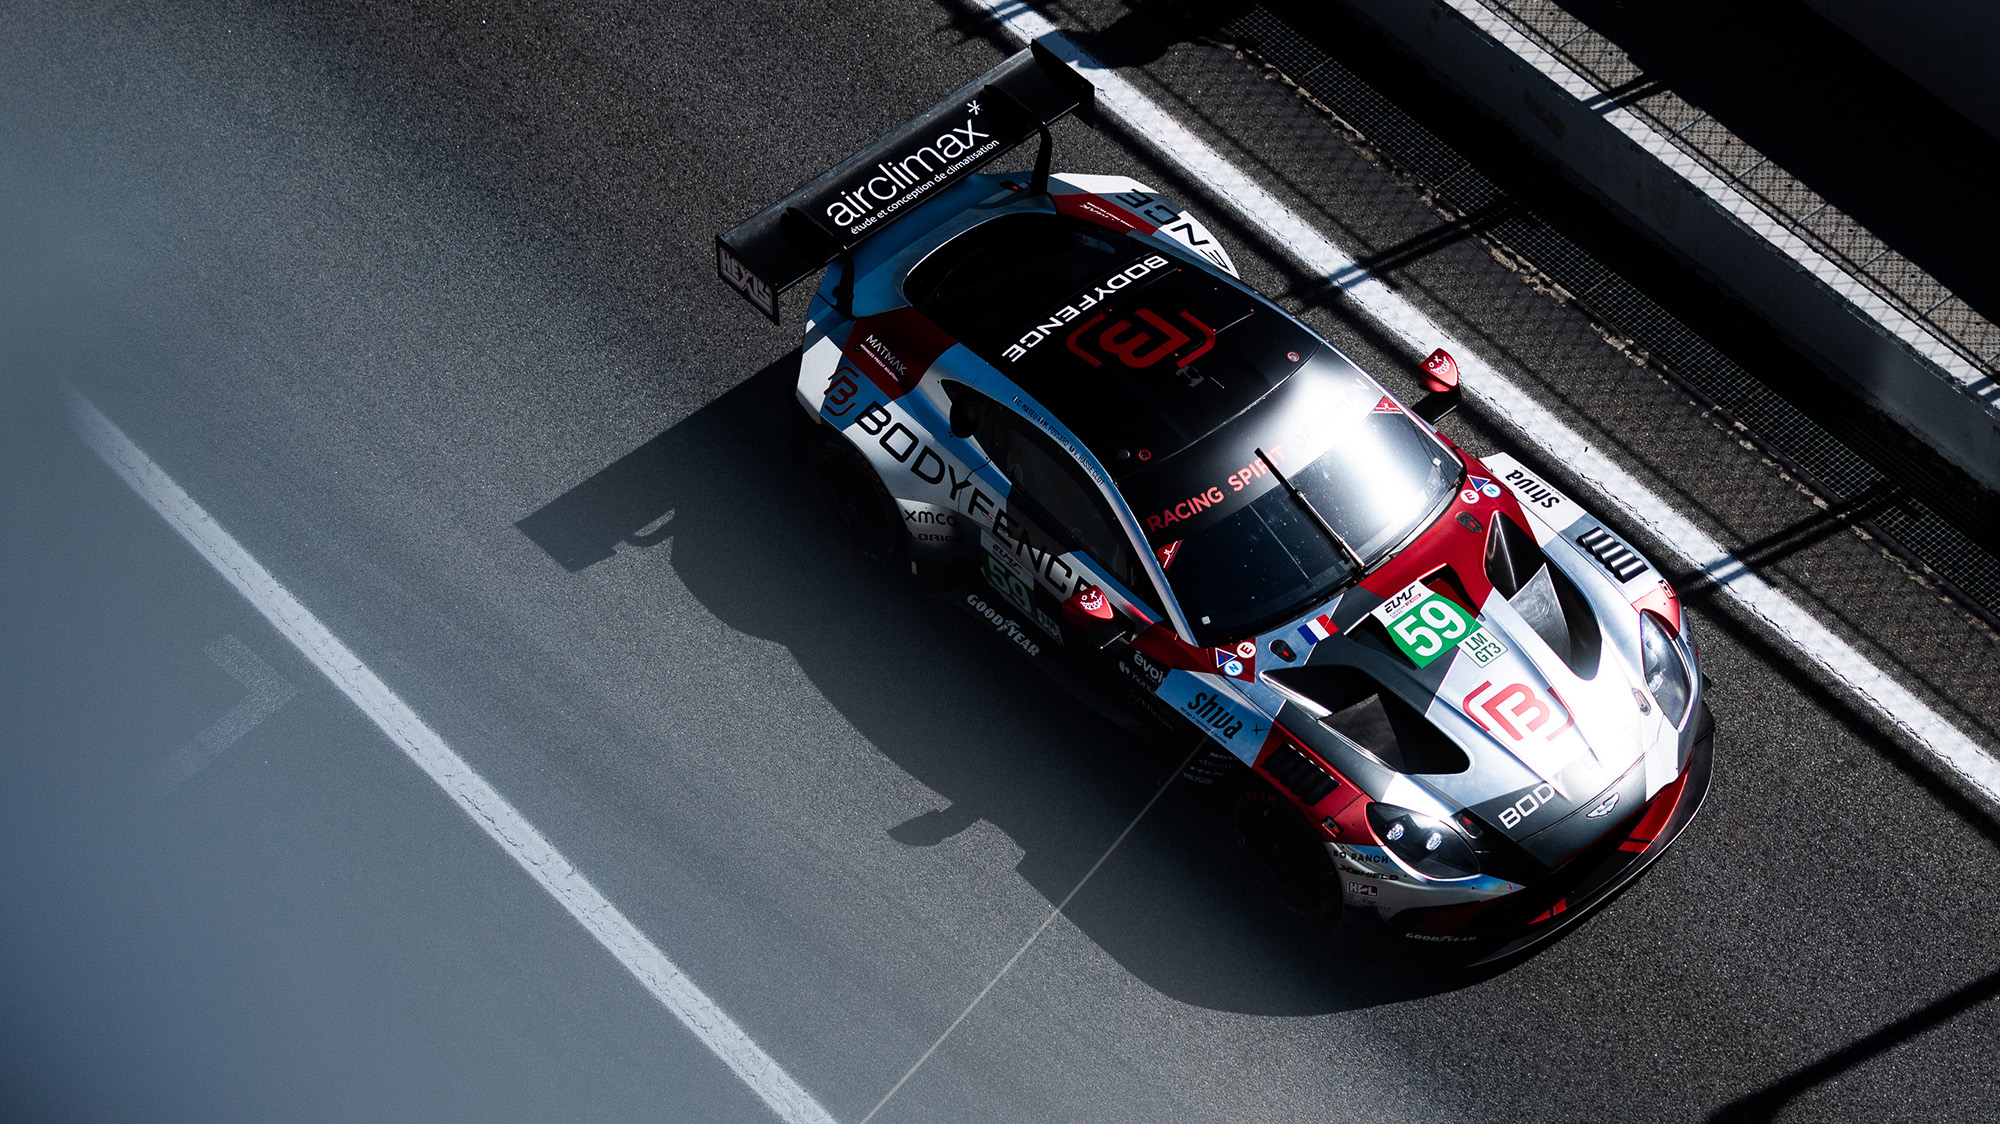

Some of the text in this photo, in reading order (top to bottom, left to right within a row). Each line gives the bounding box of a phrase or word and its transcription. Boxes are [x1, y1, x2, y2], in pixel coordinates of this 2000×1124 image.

[826, 118, 990, 227] airclimax
[850, 139, 1000, 235] étude et conception de climatisation
[719, 247, 773, 314] HEXIS
[1001, 254, 1169, 363] BODYFENCE
[866, 334, 908, 376] MATMAK
[1021, 403, 1039, 420] MATEU
[1048, 425, 1070, 447] FOSSARD
[904, 509, 957, 528] xmco
[1146, 486, 1225, 532] RACING
[986, 554, 1033, 614] 59
[1384, 584, 1416, 614] ELMS
[966, 593, 1041, 658] GOODYEAR
[1392, 600, 1467, 658] 59
[1464, 632, 1489, 652] LM
[1474, 641, 1502, 664] GT3
[1351, 853, 1389, 864] RANCH
[1405, 932, 1478, 942] GOODYEAR
